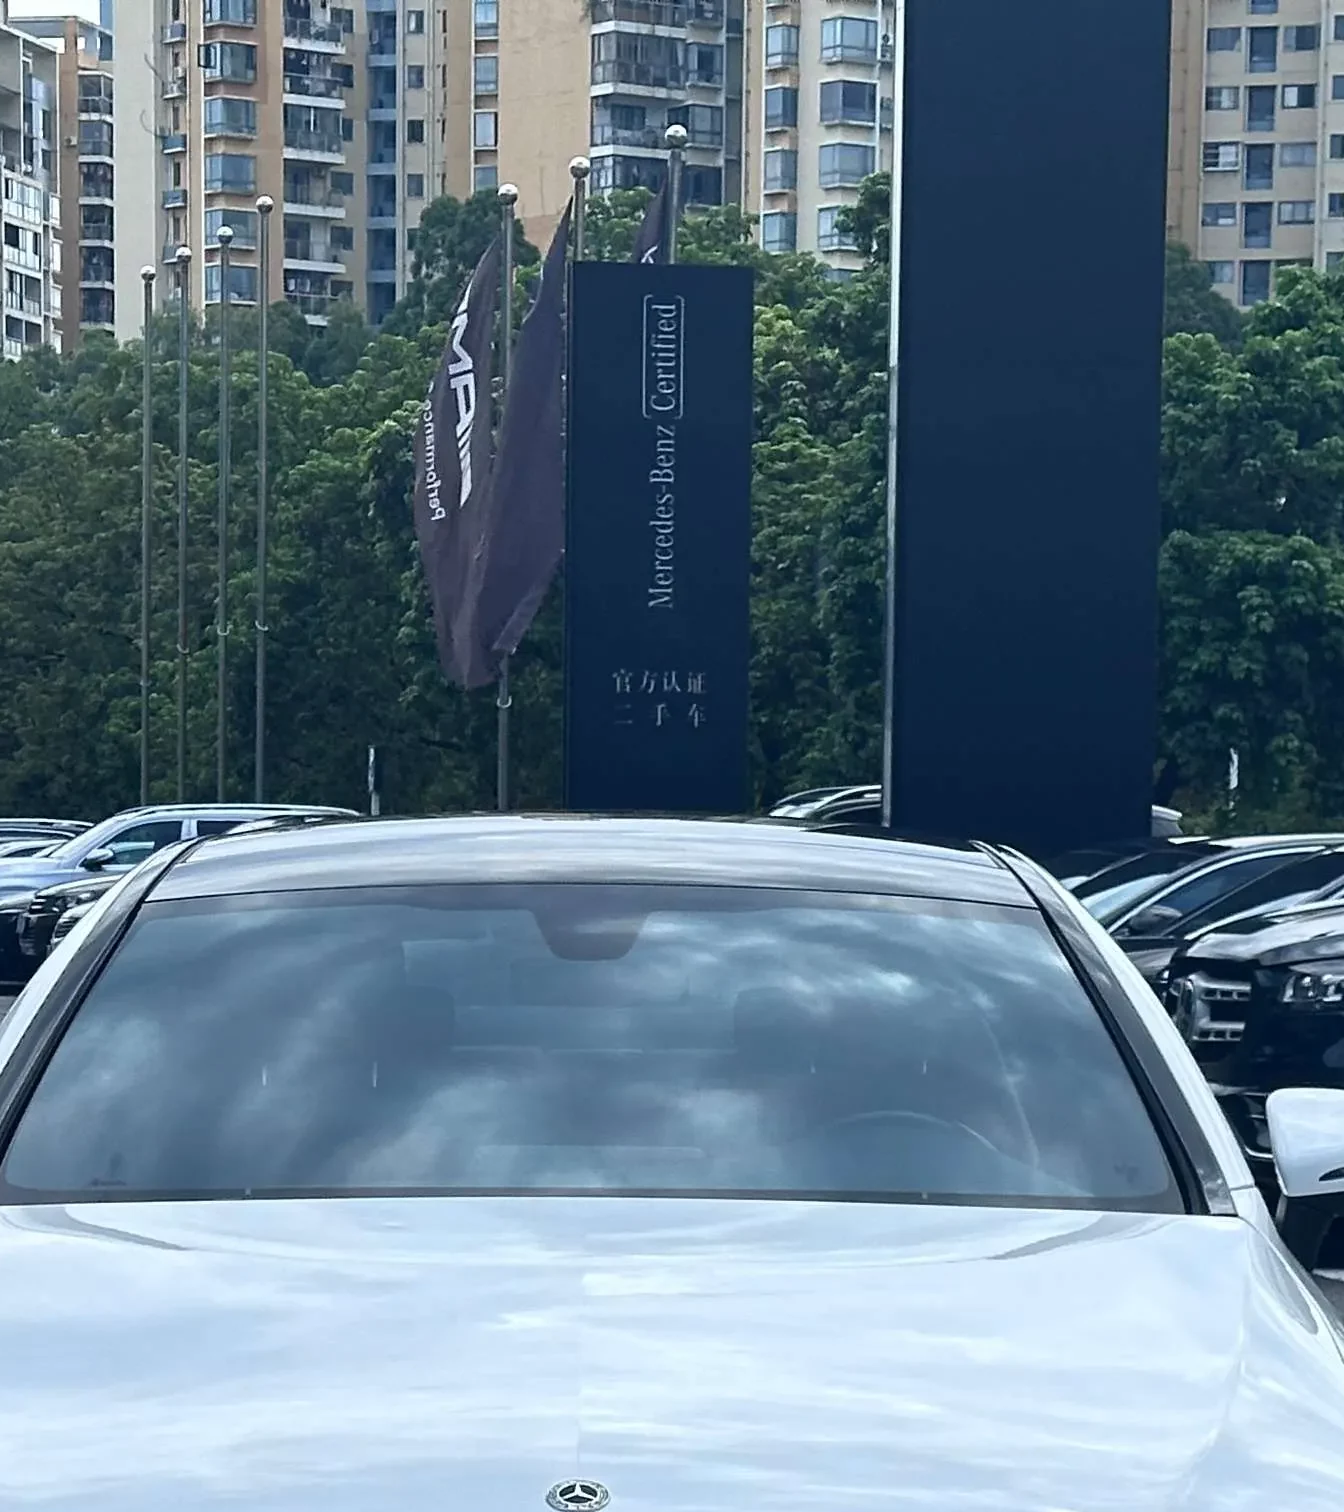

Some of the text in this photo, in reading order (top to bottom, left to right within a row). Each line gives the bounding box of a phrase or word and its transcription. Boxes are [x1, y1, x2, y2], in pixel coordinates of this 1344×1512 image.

[648, 303, 677, 609] Mercedes-Benz Certified
[612, 668, 707, 694] 官方认证
[613, 703, 707, 728] 二手车
